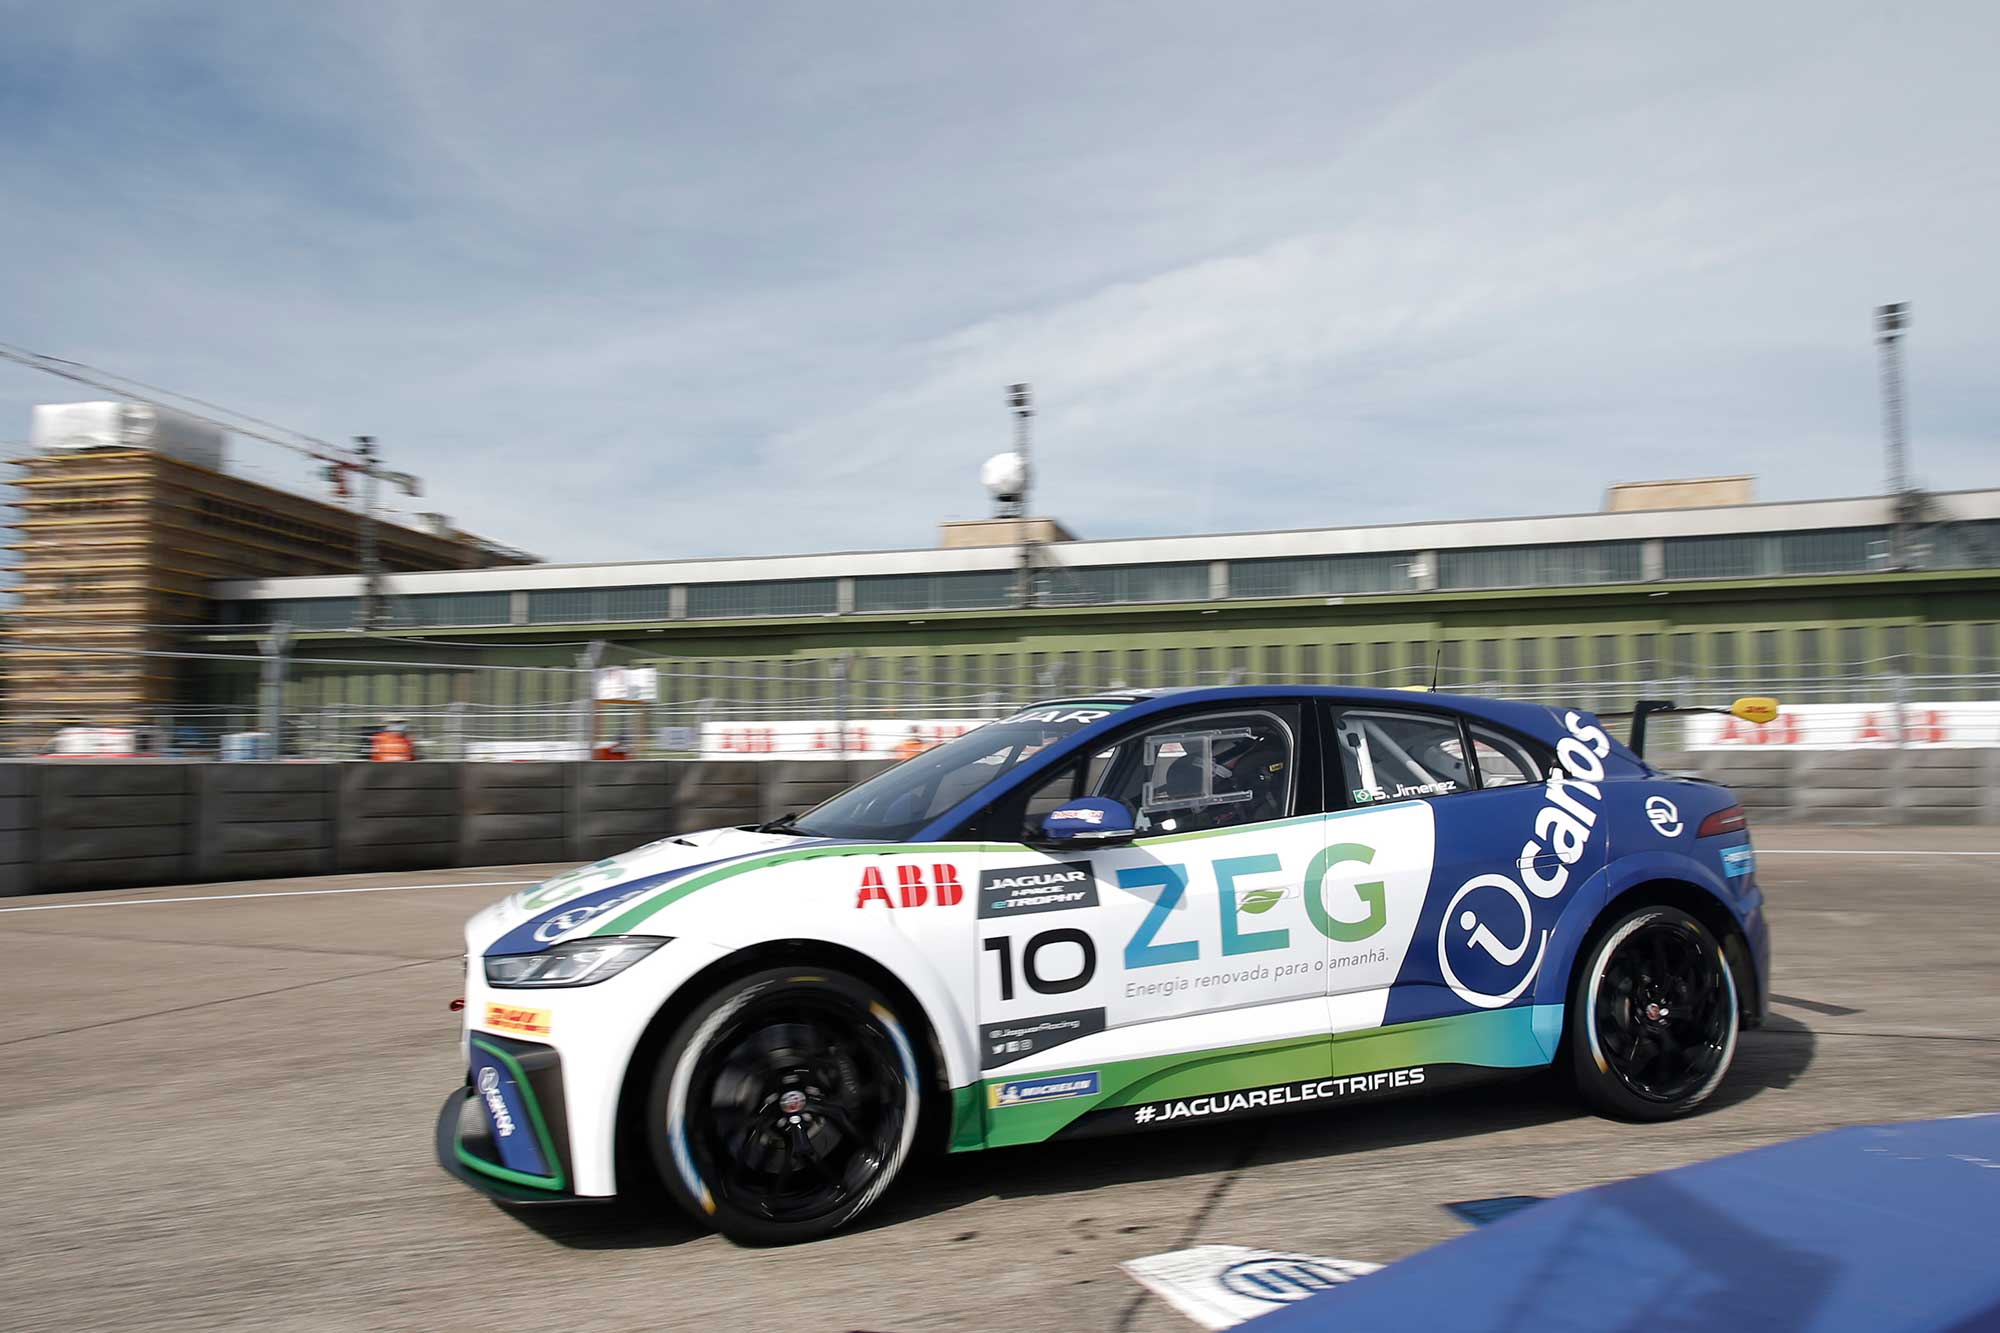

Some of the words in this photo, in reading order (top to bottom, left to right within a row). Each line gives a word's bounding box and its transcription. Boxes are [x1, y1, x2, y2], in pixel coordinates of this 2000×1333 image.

[1373, 786, 1390, 801] S.
[1392, 780, 1457, 797] Jimenez
[855, 863, 964, 909] ABB
[984, 871, 1086, 890] JAGUAR
[991, 892, 1086, 909] eTROPHY
[1116, 842, 1387, 970] ZEG
[983, 927, 1097, 1001] 10
[1124, 976, 1189, 998] Energia
[1194, 965, 1269, 989] renovada
[1274, 959, 1308, 983] para
[1314, 960, 1324, 971] o
[988, 1020, 1081, 1039] @JaguarRacing
[1020, 1079, 1092, 1097] MICHELIN
[1134, 1067, 1425, 1124] #JAGUARELECTRIFIES
